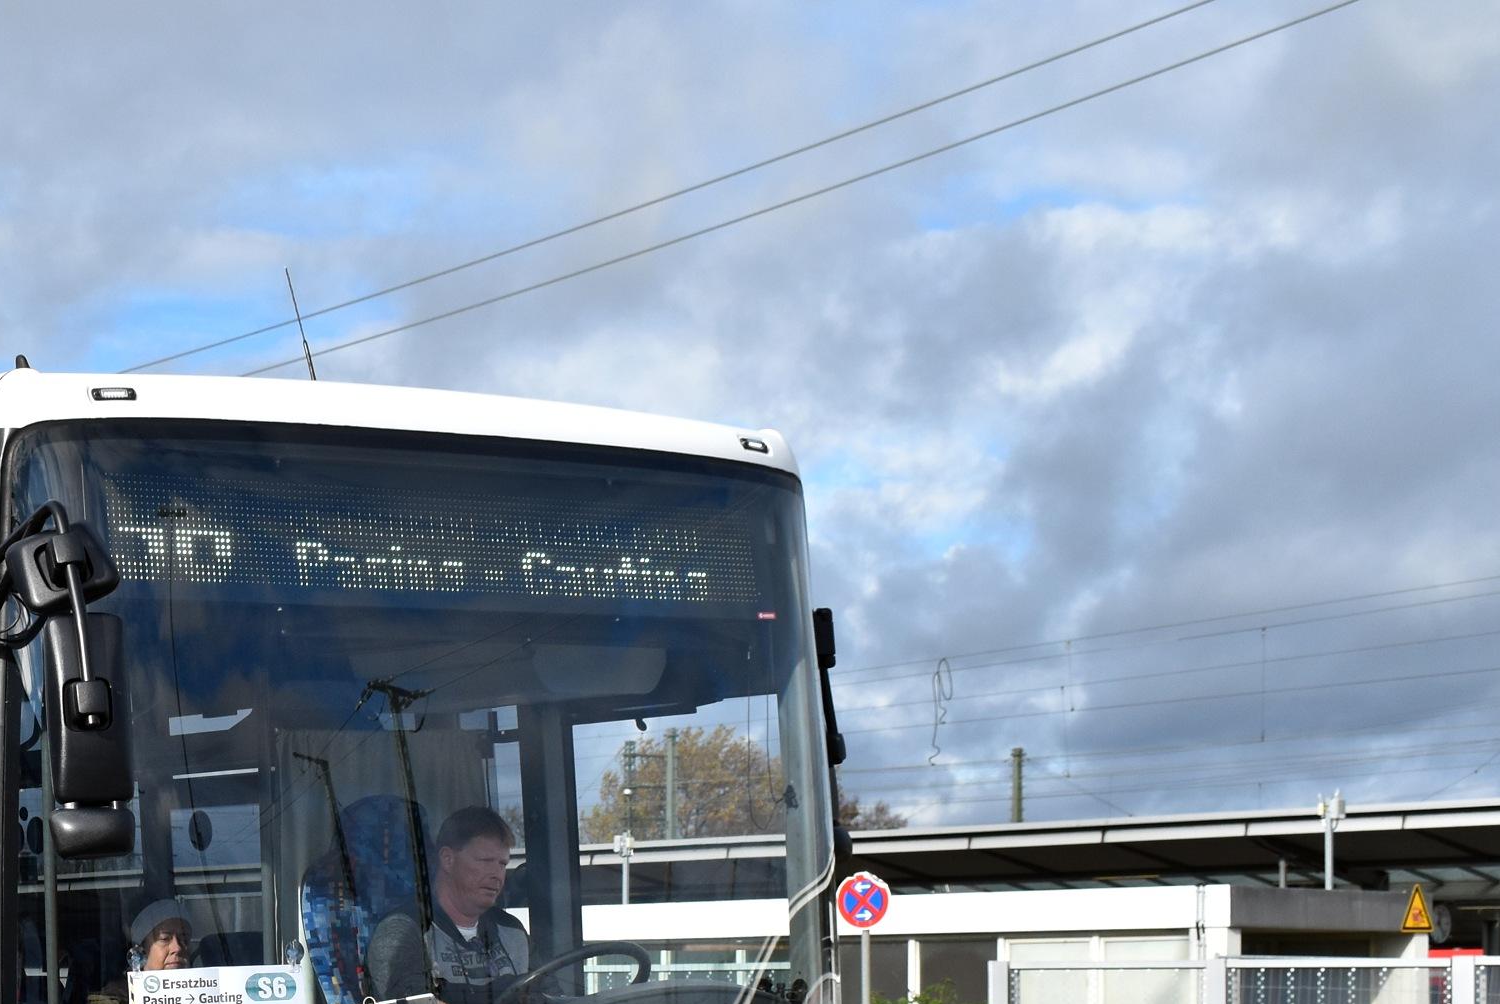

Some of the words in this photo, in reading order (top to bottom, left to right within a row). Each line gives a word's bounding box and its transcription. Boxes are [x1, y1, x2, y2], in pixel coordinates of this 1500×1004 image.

[296, 542, 463, 590] Pasing
[522, 551, 707, 601] Gauting
[162, 977, 218, 990] Ersatzbus
[257, 976, 287, 999] S6
[199, 992, 243, 1004] Gauting
